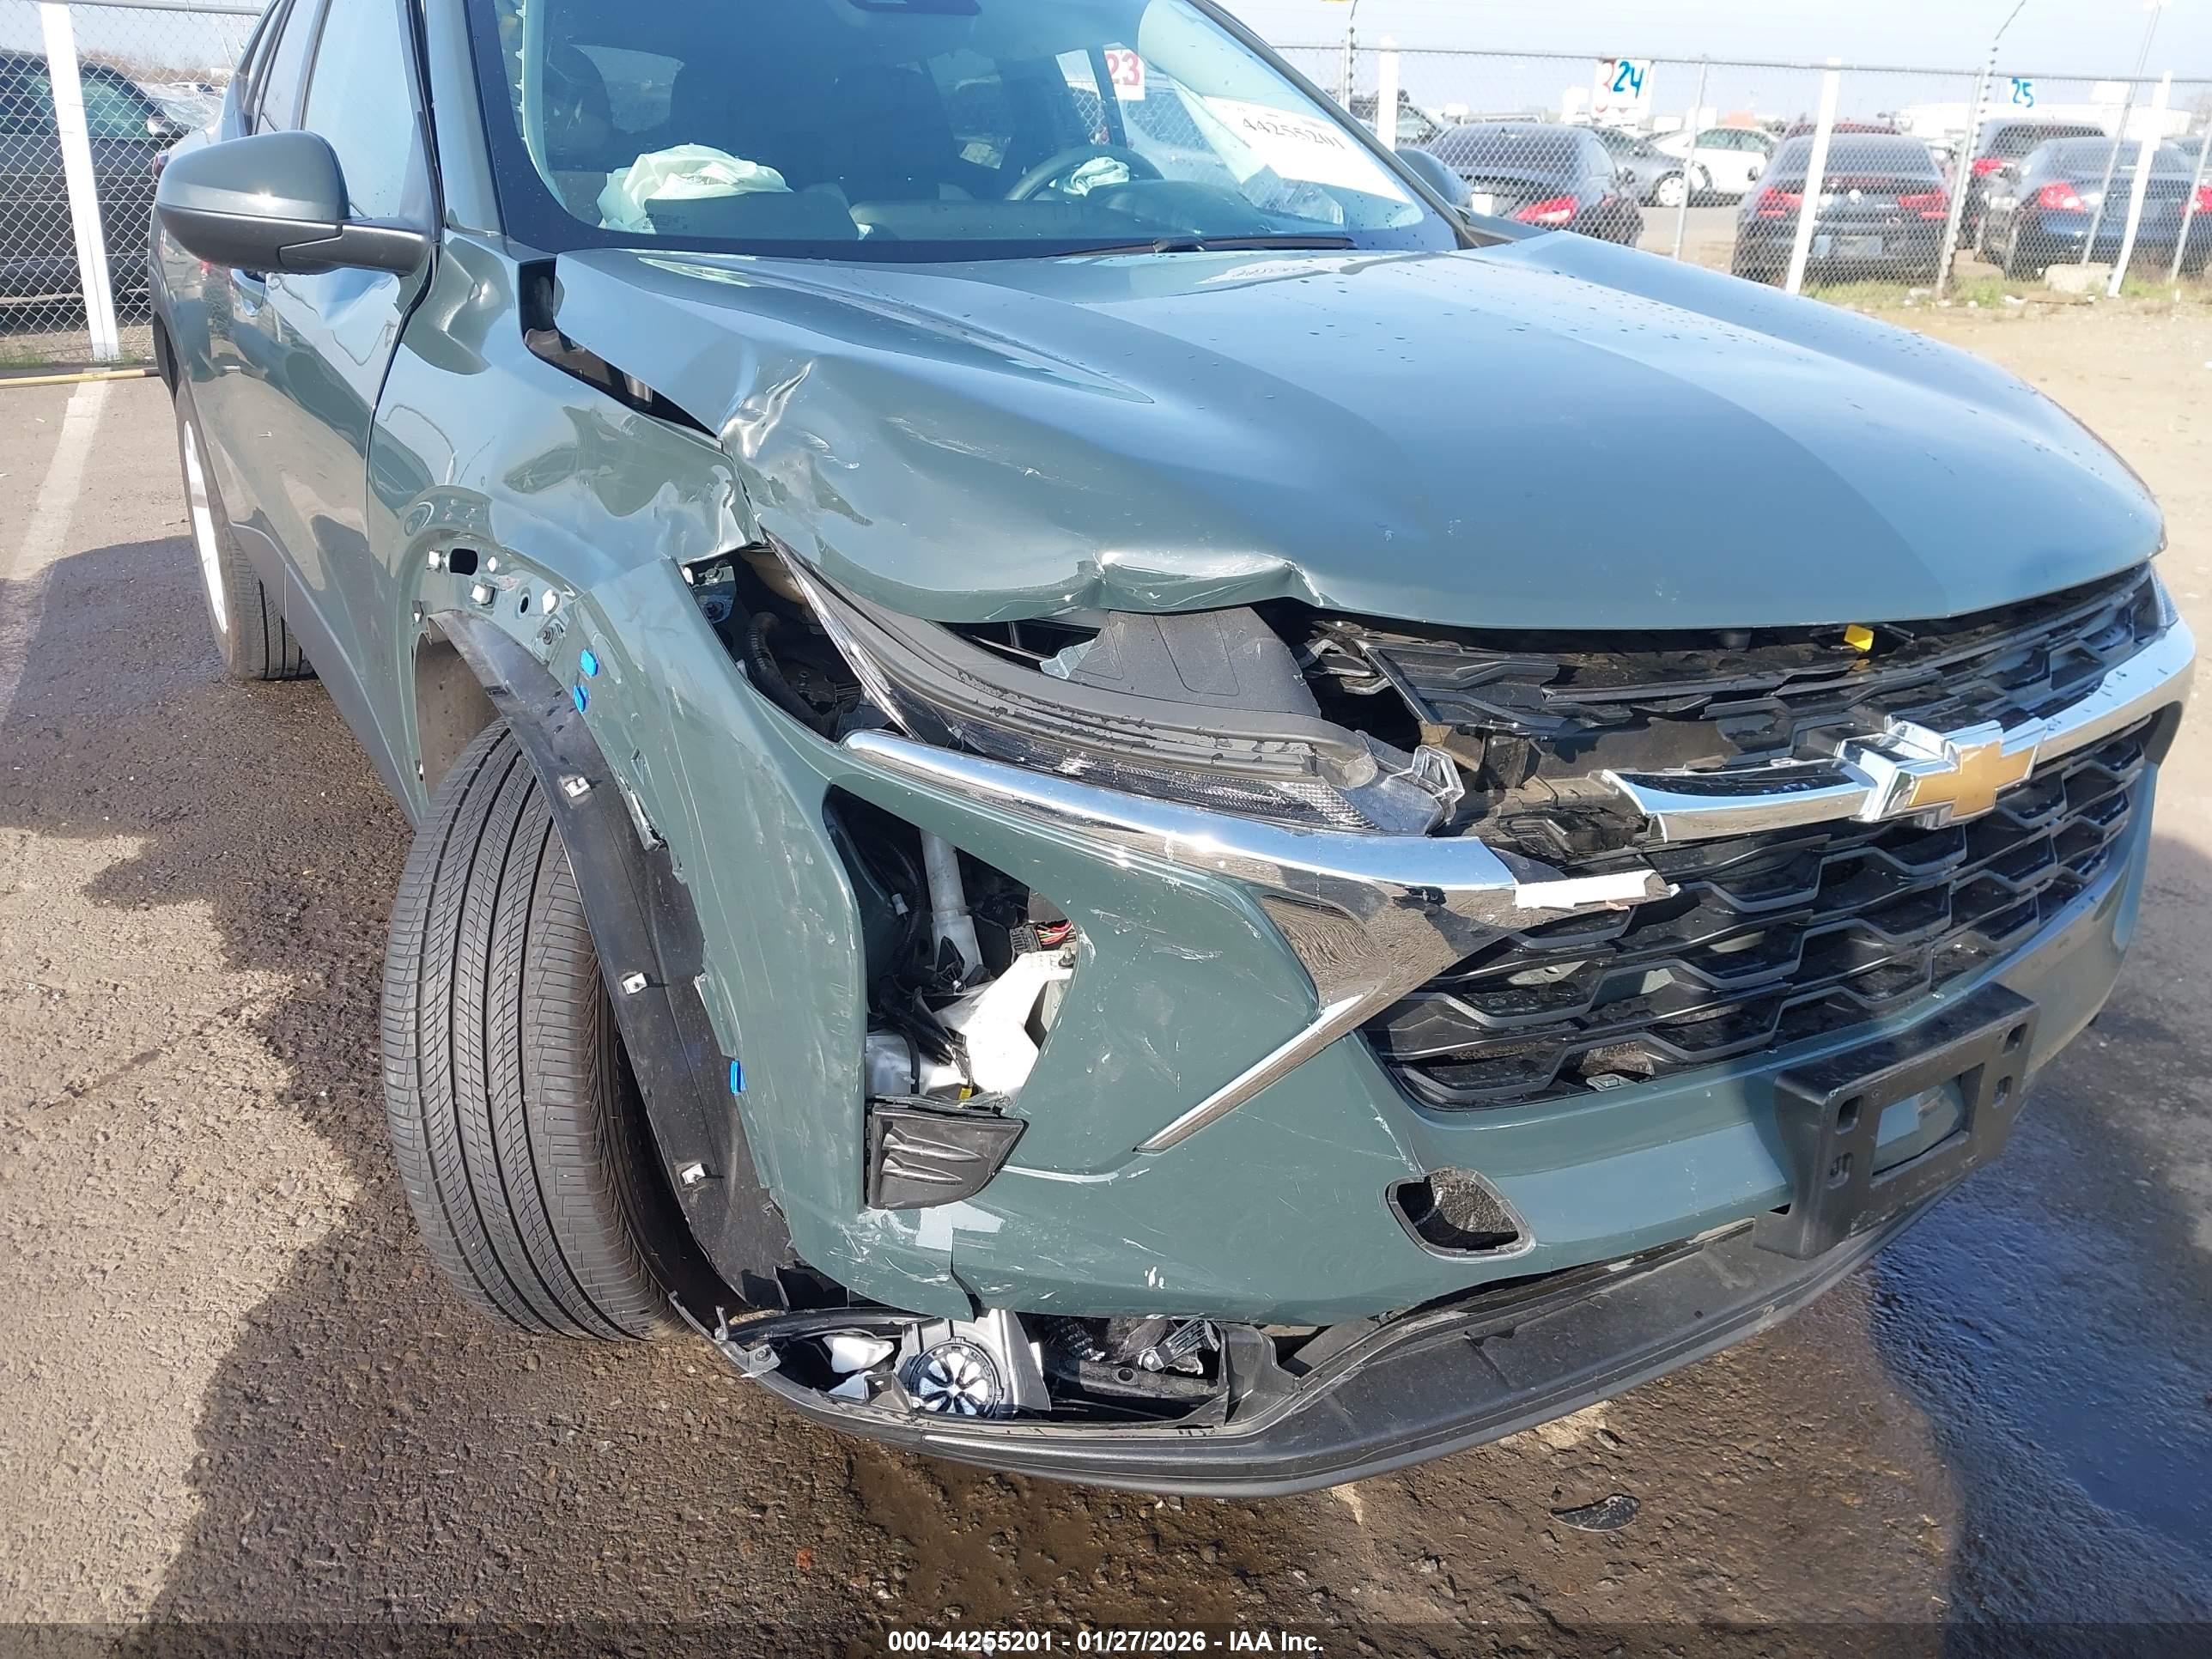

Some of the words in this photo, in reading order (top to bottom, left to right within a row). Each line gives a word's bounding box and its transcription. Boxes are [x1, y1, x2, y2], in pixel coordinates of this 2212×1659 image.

[1105, 52, 1139, 85] 23
[1613, 61, 1644, 99] 24
[2011, 78, 2034, 108] 25
